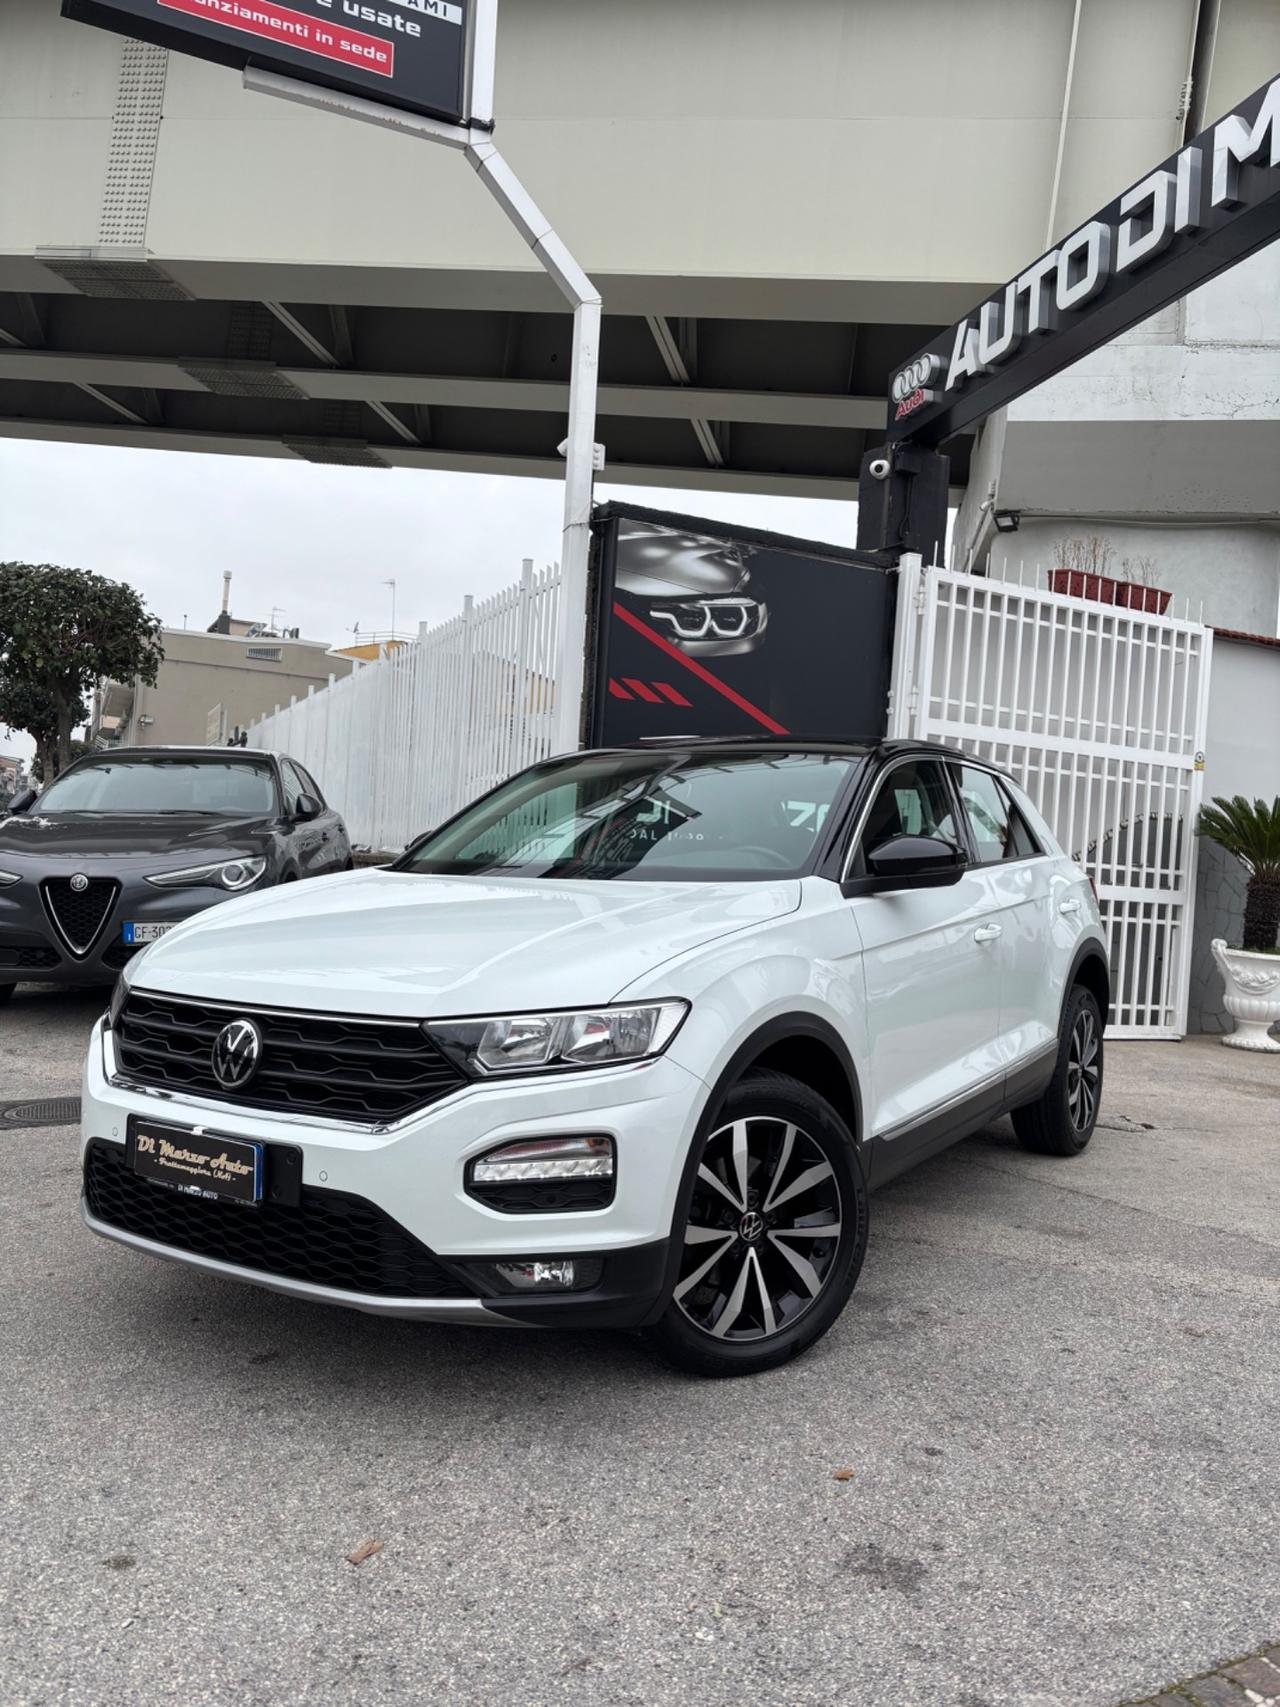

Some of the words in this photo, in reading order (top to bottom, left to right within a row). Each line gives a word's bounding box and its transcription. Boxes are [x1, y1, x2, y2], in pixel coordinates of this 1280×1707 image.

[342, 0, 422, 38] usate
[315, 29, 334, 46] in
[339, 39, 388, 63] sede
[945, 220, 1109, 391] AUTO
[895, 388, 925, 421] Audi
[210, 1152, 254, 1176] Auto
